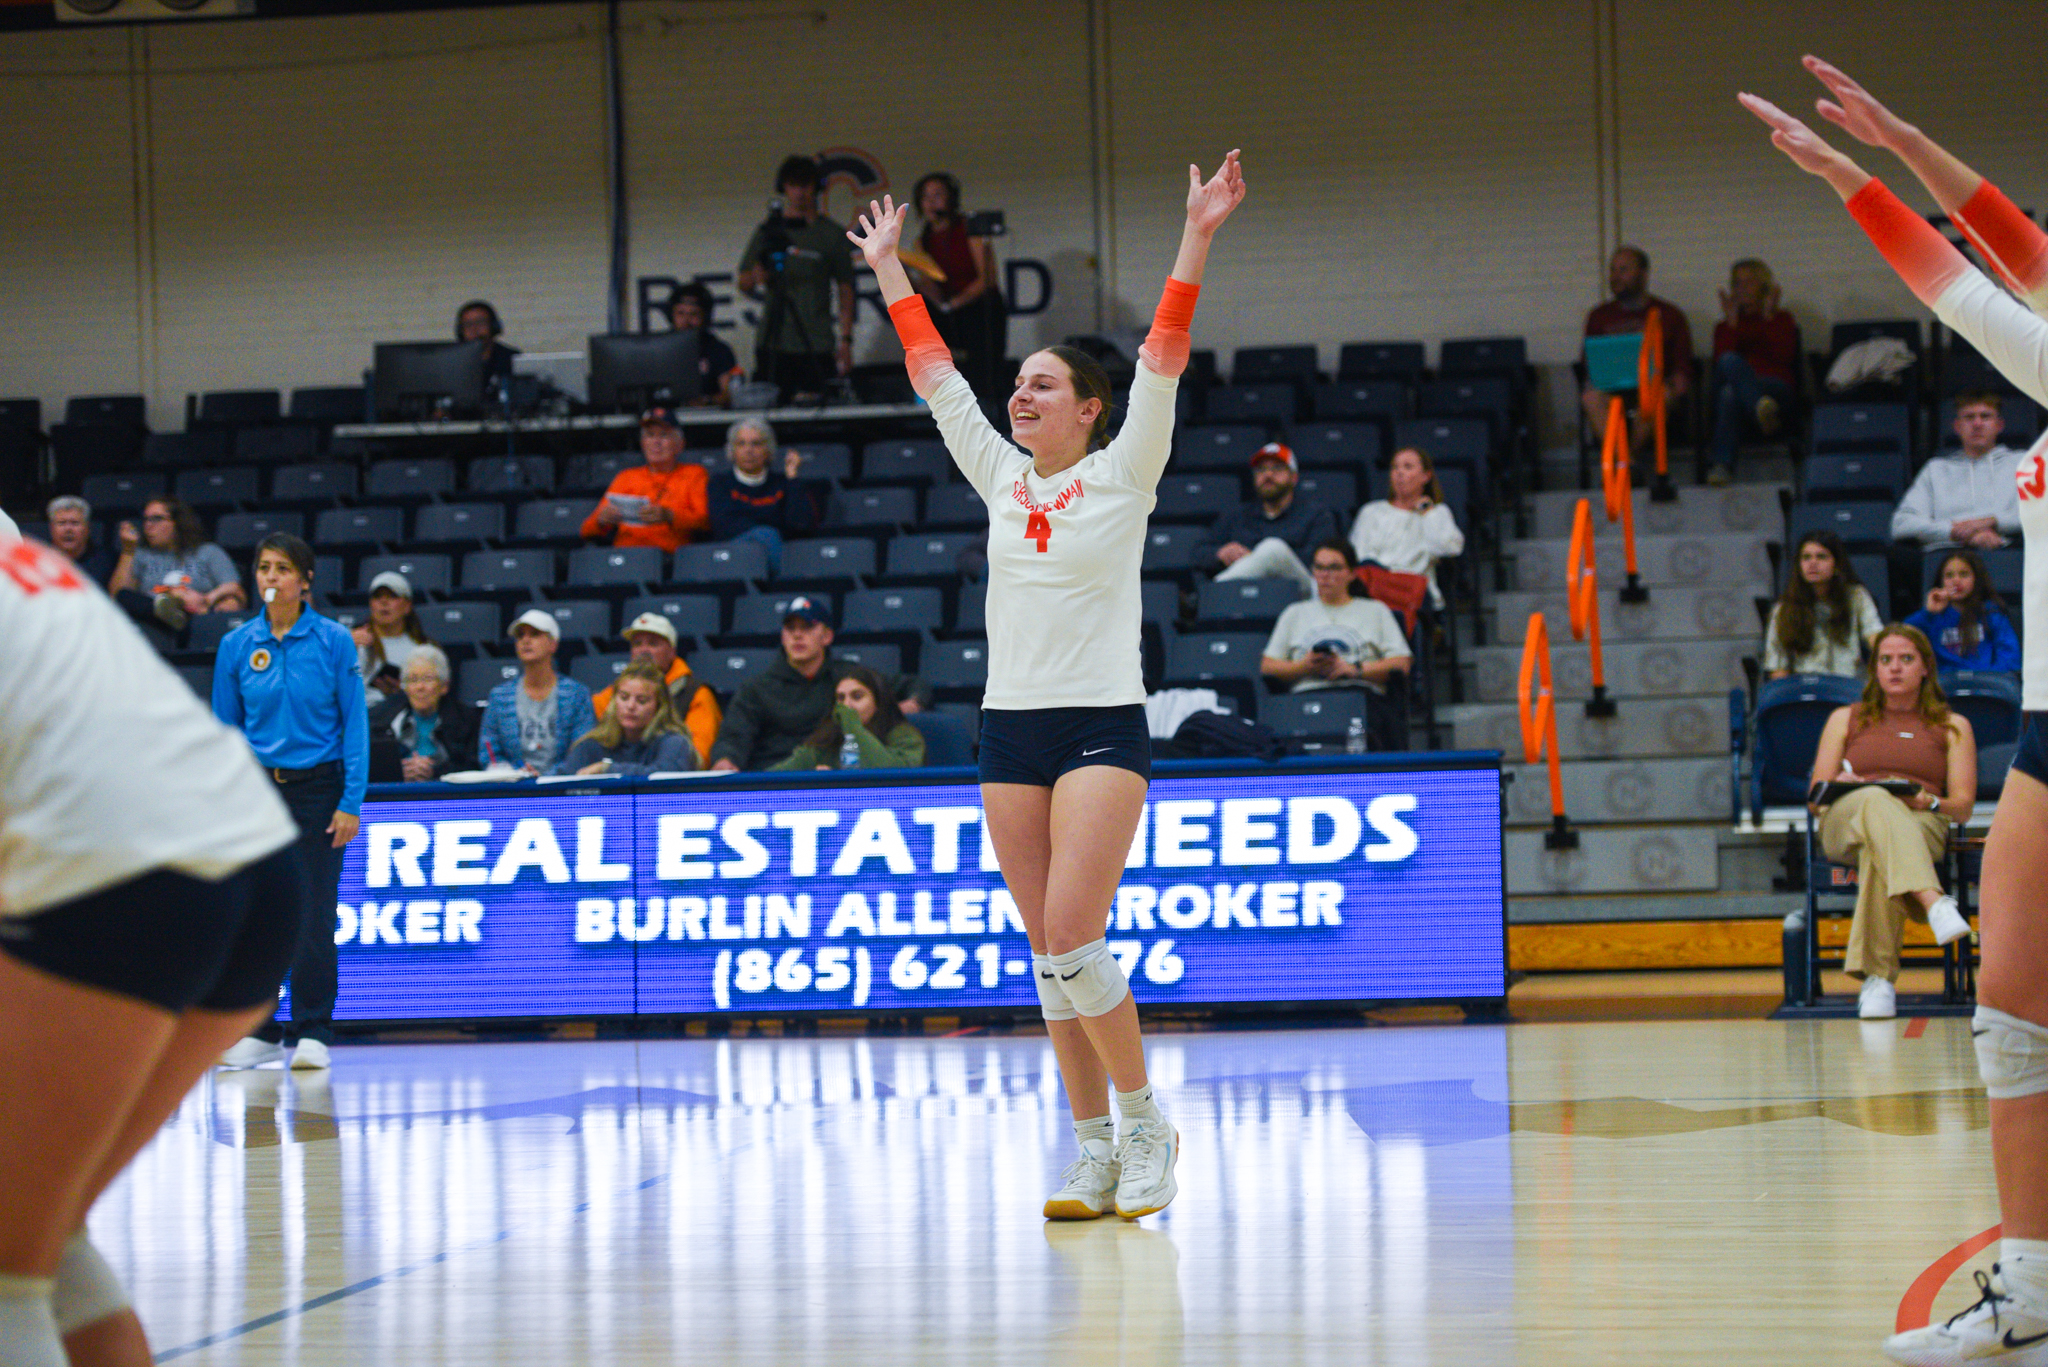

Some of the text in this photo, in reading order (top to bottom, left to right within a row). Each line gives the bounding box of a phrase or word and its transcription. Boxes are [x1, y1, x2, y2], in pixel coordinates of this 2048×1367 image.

[1023, 511, 1053, 553] 4
[366, 817, 631, 889] REAL
[575, 893, 813, 943] BURLIN
[1105, 881, 1343, 931] ROKER
[713, 938, 1185, 1009] (865) 621-76
